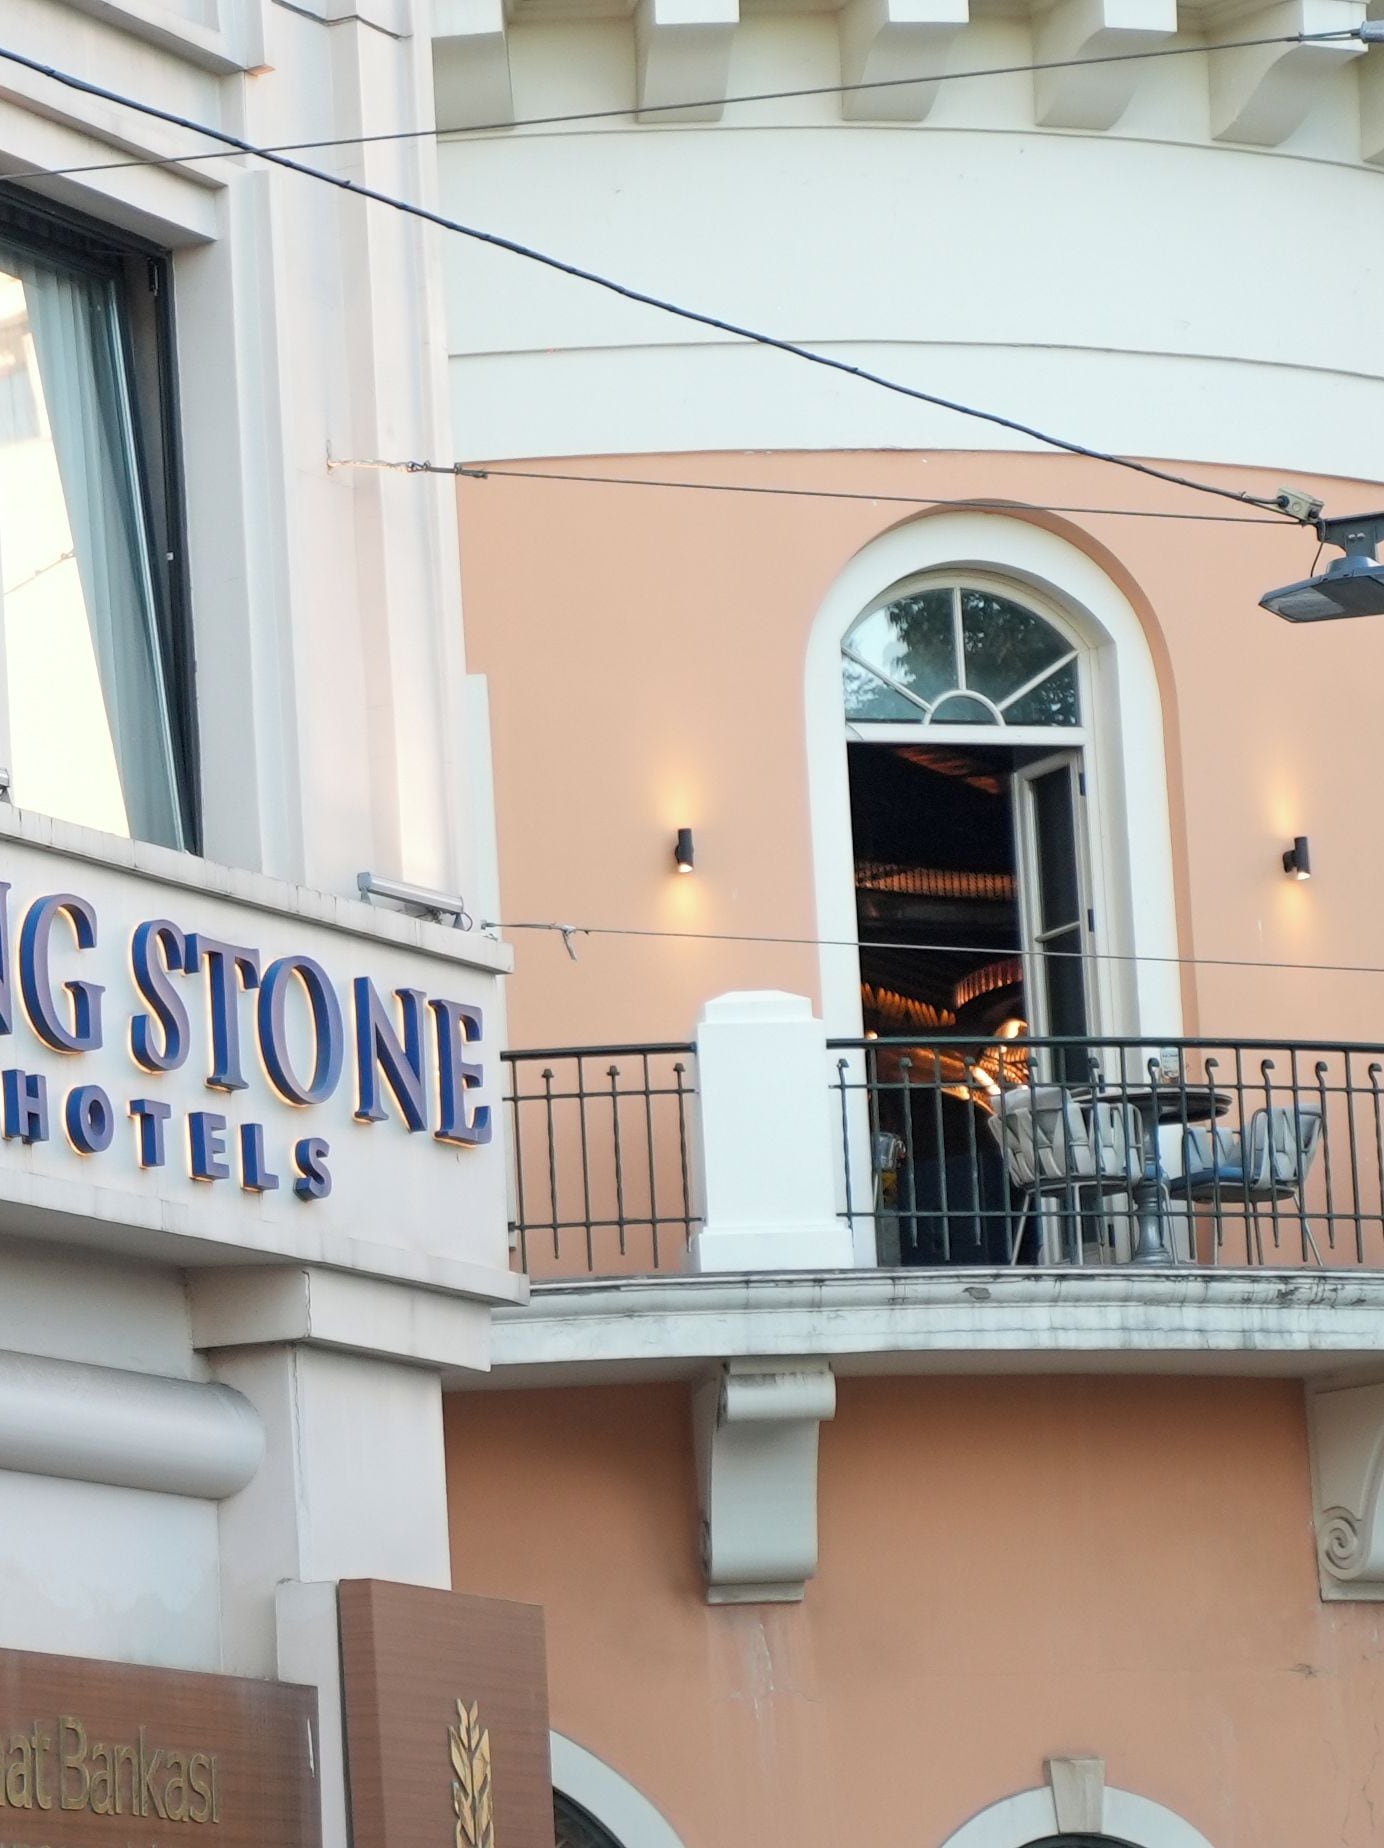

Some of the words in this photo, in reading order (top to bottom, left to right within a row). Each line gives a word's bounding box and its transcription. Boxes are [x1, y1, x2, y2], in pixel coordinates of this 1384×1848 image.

[130, 918, 493, 1146] STONE
[1, 1067, 333, 1201] HOTELS
[59, 1715, 220, 1823] Bankası
